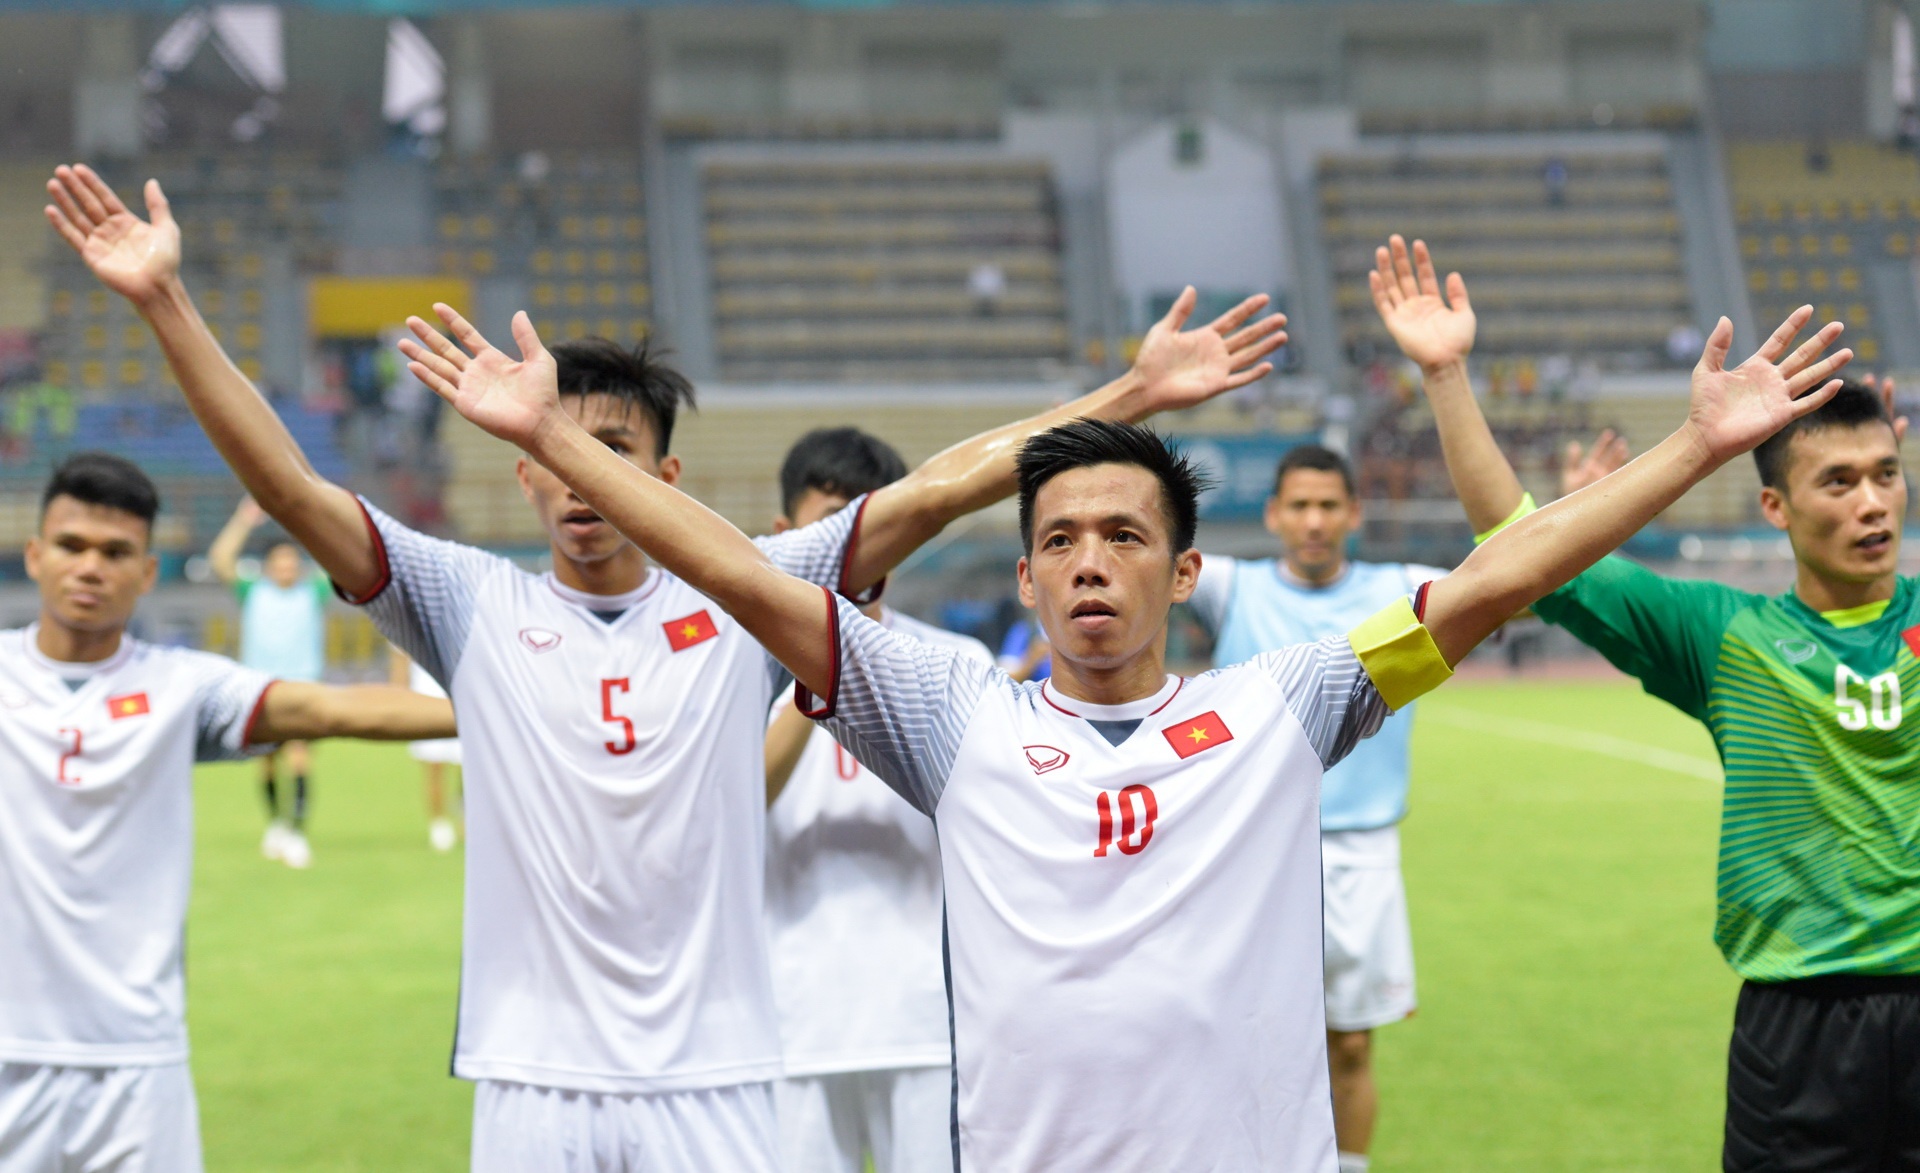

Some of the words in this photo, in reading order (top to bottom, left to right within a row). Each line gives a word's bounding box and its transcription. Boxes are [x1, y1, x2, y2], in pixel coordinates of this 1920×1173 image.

[601, 677, 636, 756] 5
[1835, 663, 1902, 731] 50
[58, 727, 83, 784] 2
[1093, 783, 1158, 858] 10
